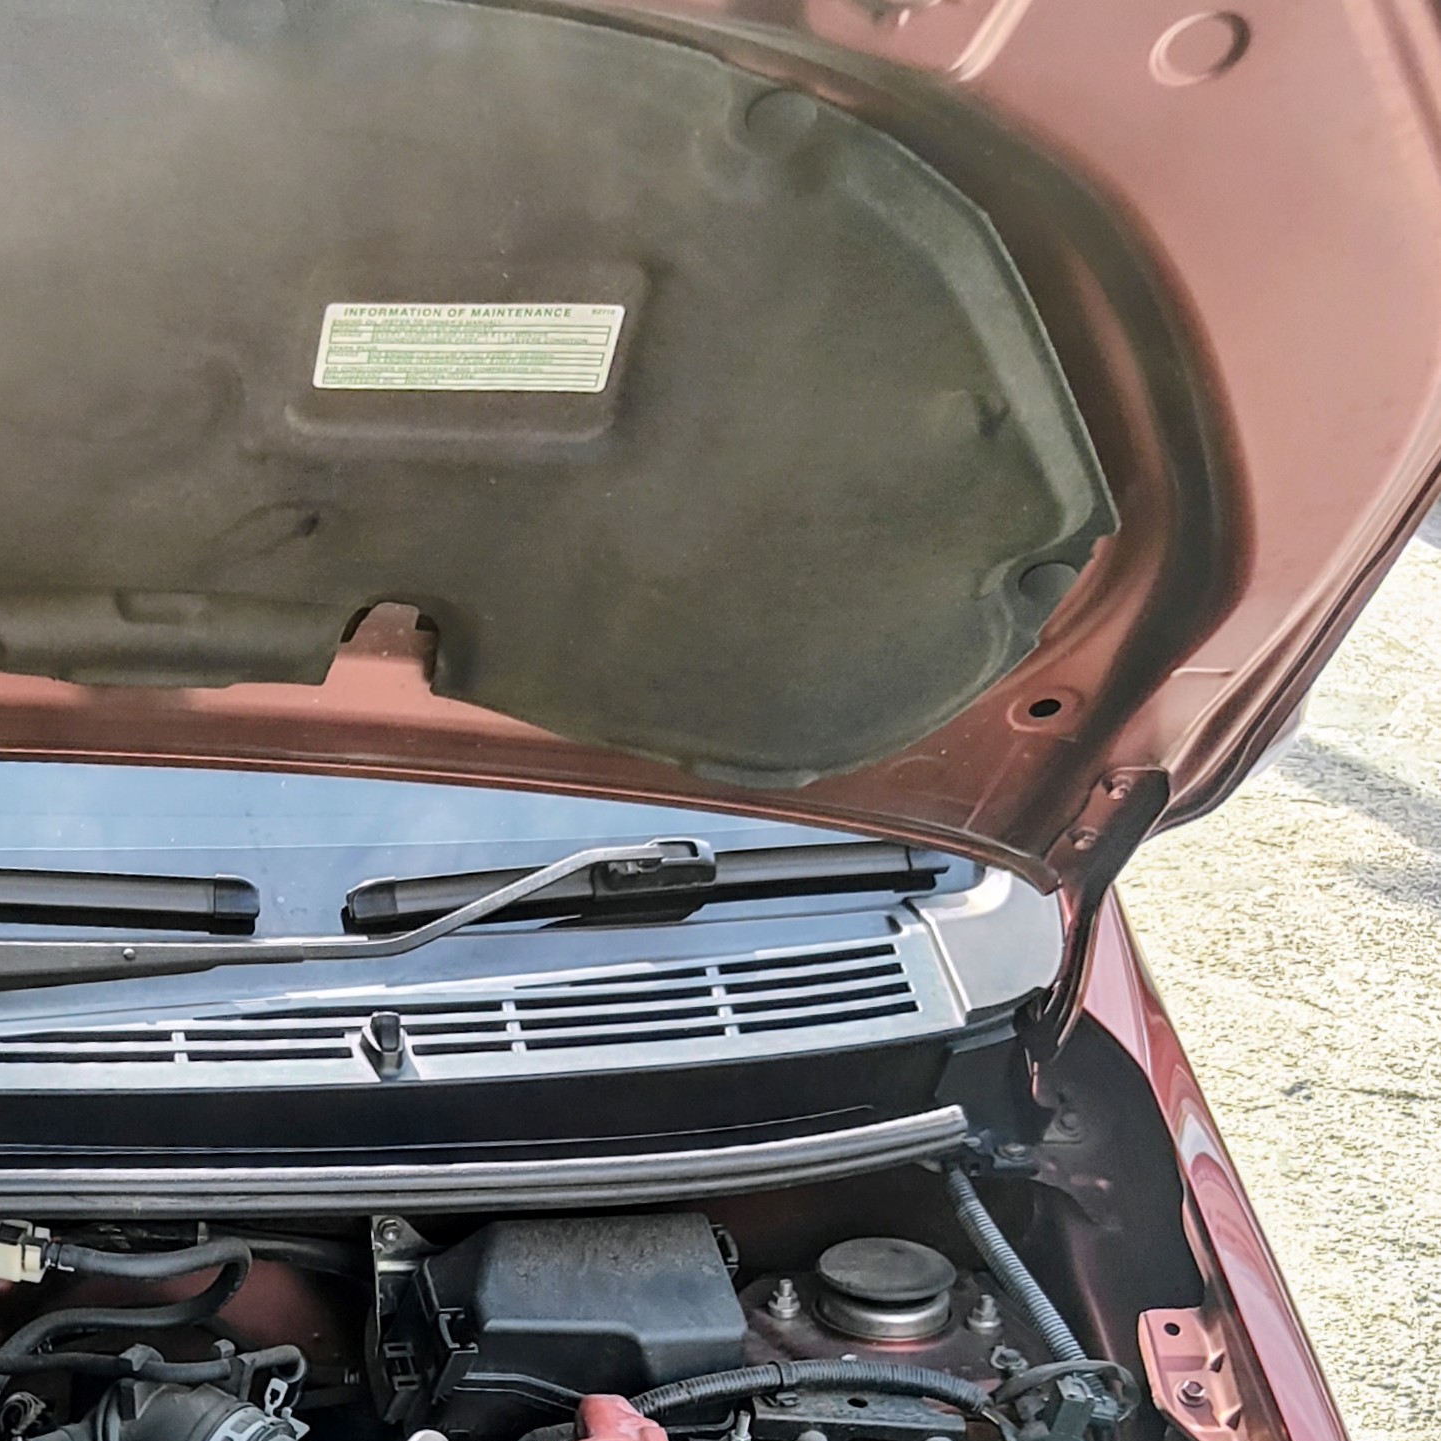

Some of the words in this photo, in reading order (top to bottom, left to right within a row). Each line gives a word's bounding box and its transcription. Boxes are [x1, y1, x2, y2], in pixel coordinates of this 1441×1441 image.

[343, 307, 442, 318] INFORMATION
[447, 308, 467, 318] OF
[470, 308, 572, 318] MAINTENANCE
